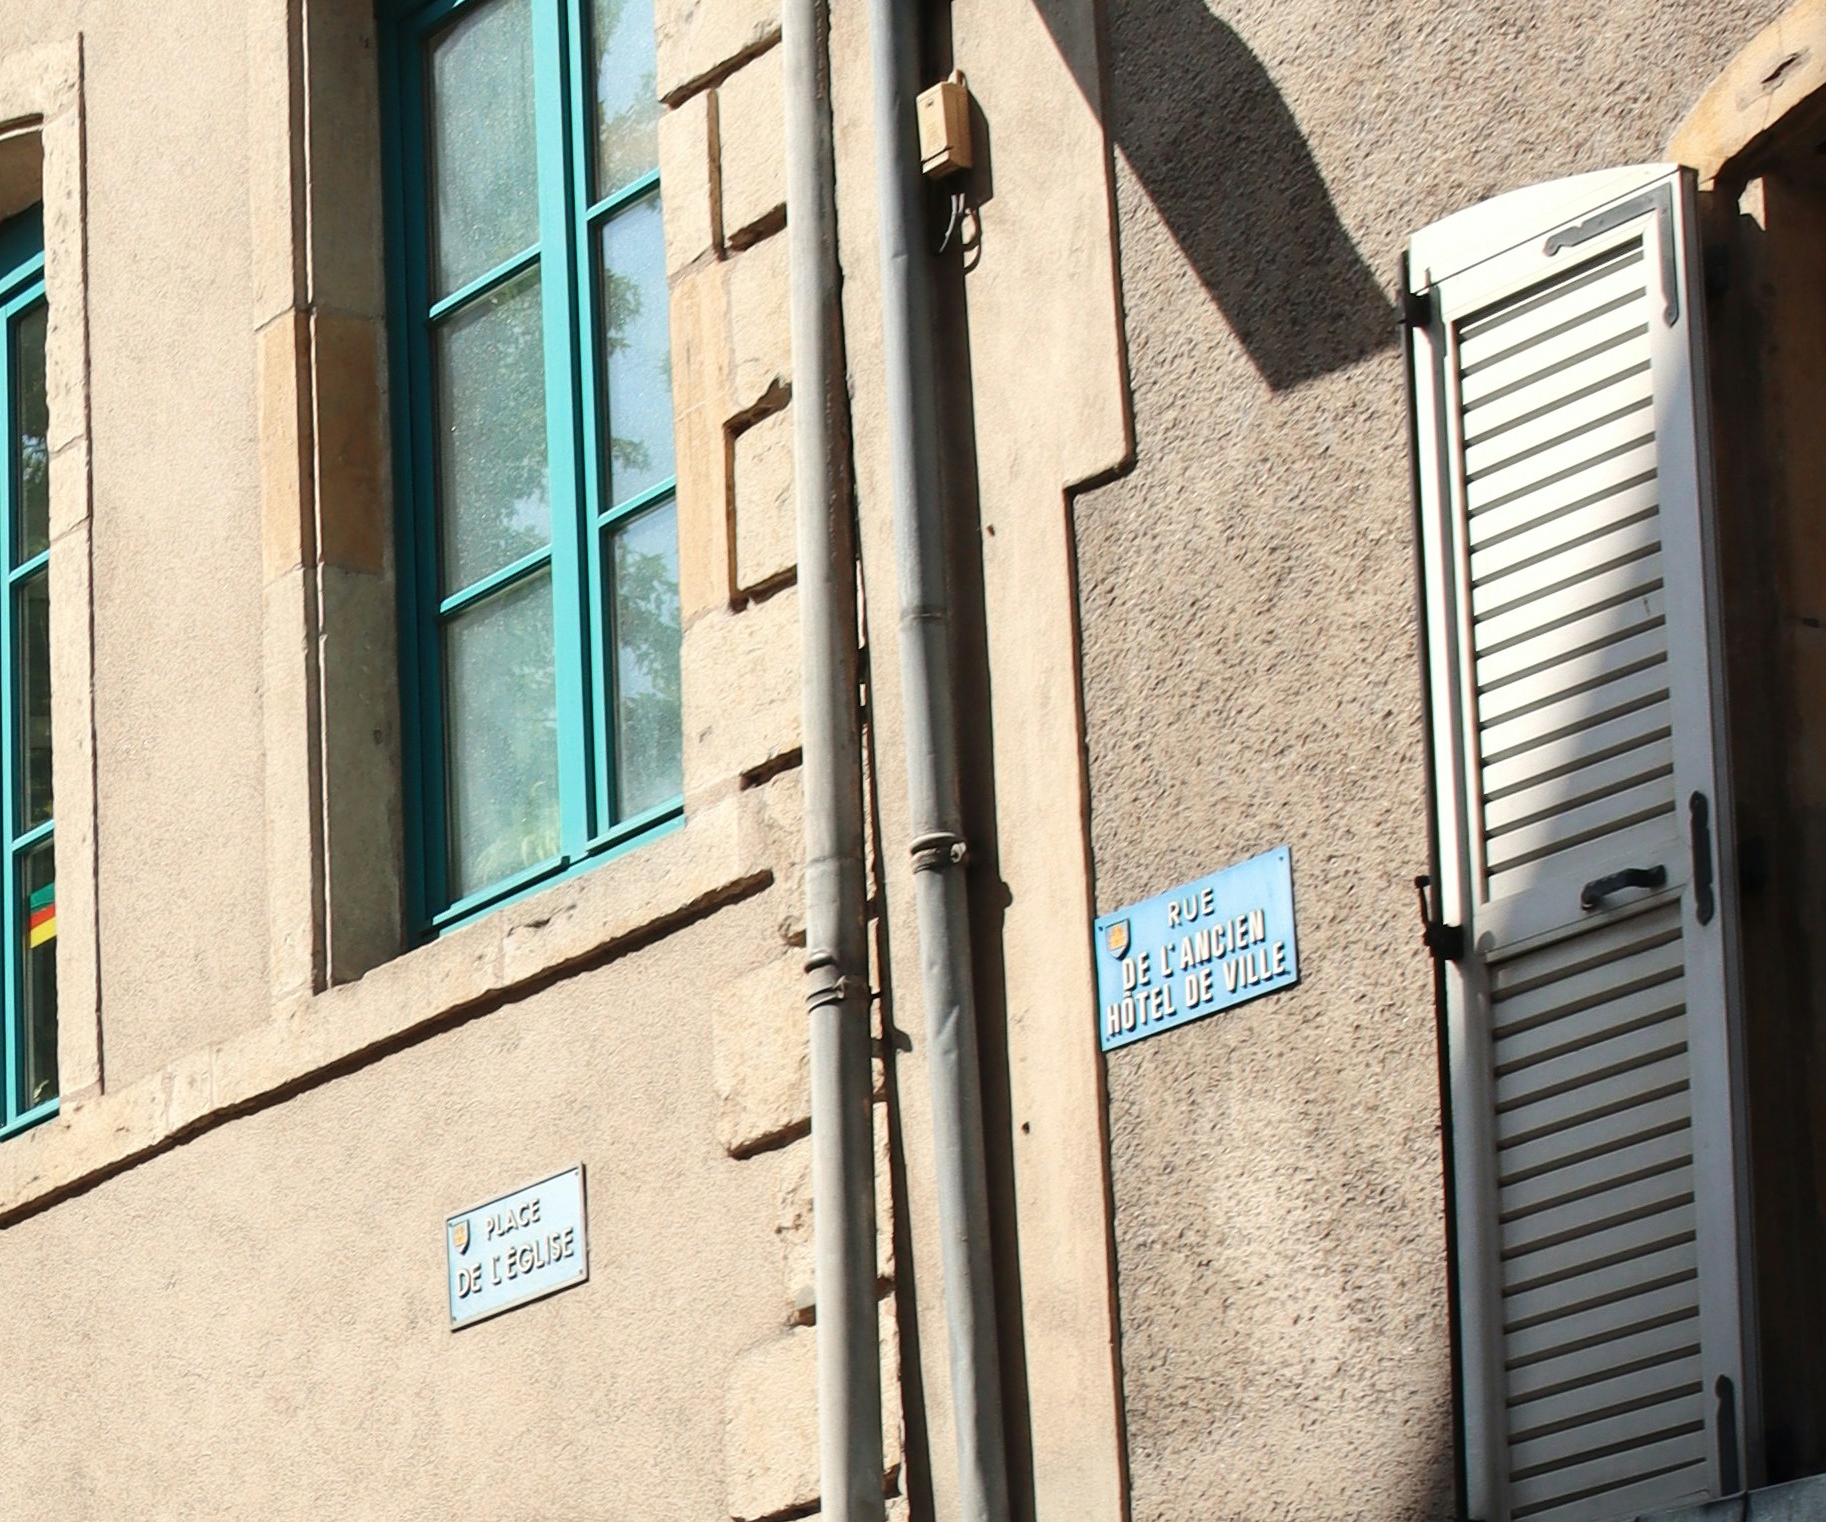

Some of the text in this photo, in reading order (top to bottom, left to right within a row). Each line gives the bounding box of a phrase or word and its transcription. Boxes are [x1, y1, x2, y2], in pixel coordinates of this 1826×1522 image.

[1168, 887, 1215, 927] RUE
[1121, 908, 1266, 992] DE L'ANCIEN
[1106, 941, 1286, 1037] HÔTEL DE VILLE
[486, 1199, 541, 1240] PLACE
[458, 1226, 574, 1299] DE L'ÉGLISE
